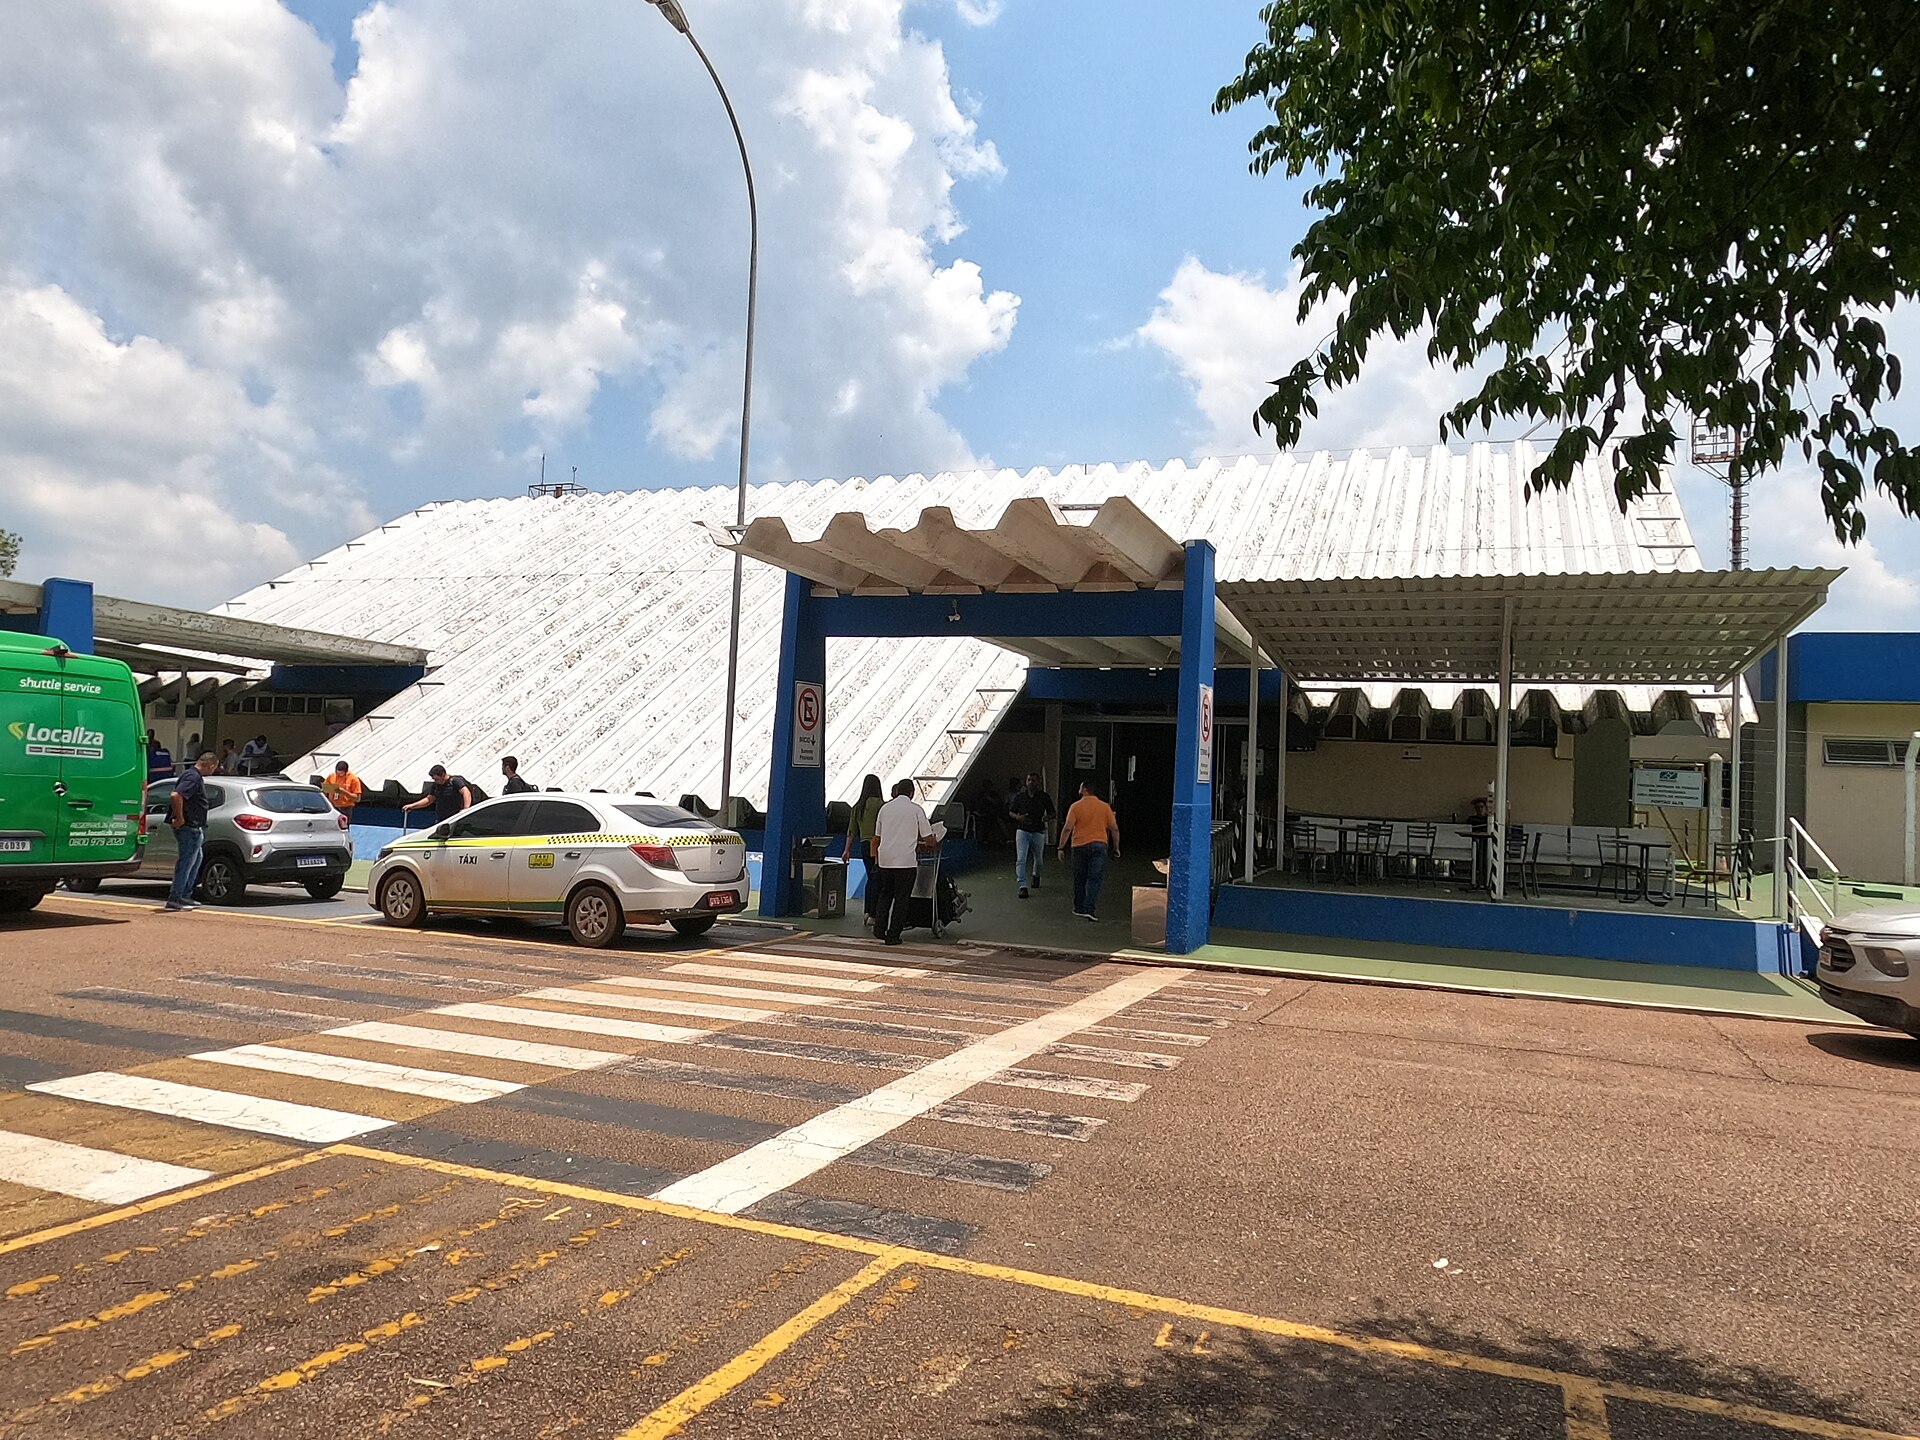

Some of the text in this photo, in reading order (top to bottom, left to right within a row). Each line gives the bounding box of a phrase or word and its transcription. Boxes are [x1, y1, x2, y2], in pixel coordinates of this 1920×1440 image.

[19, 677, 101, 694] shuttle service
[26, 723, 104, 745] Localiza
[458, 853, 478, 865] TÁXI
